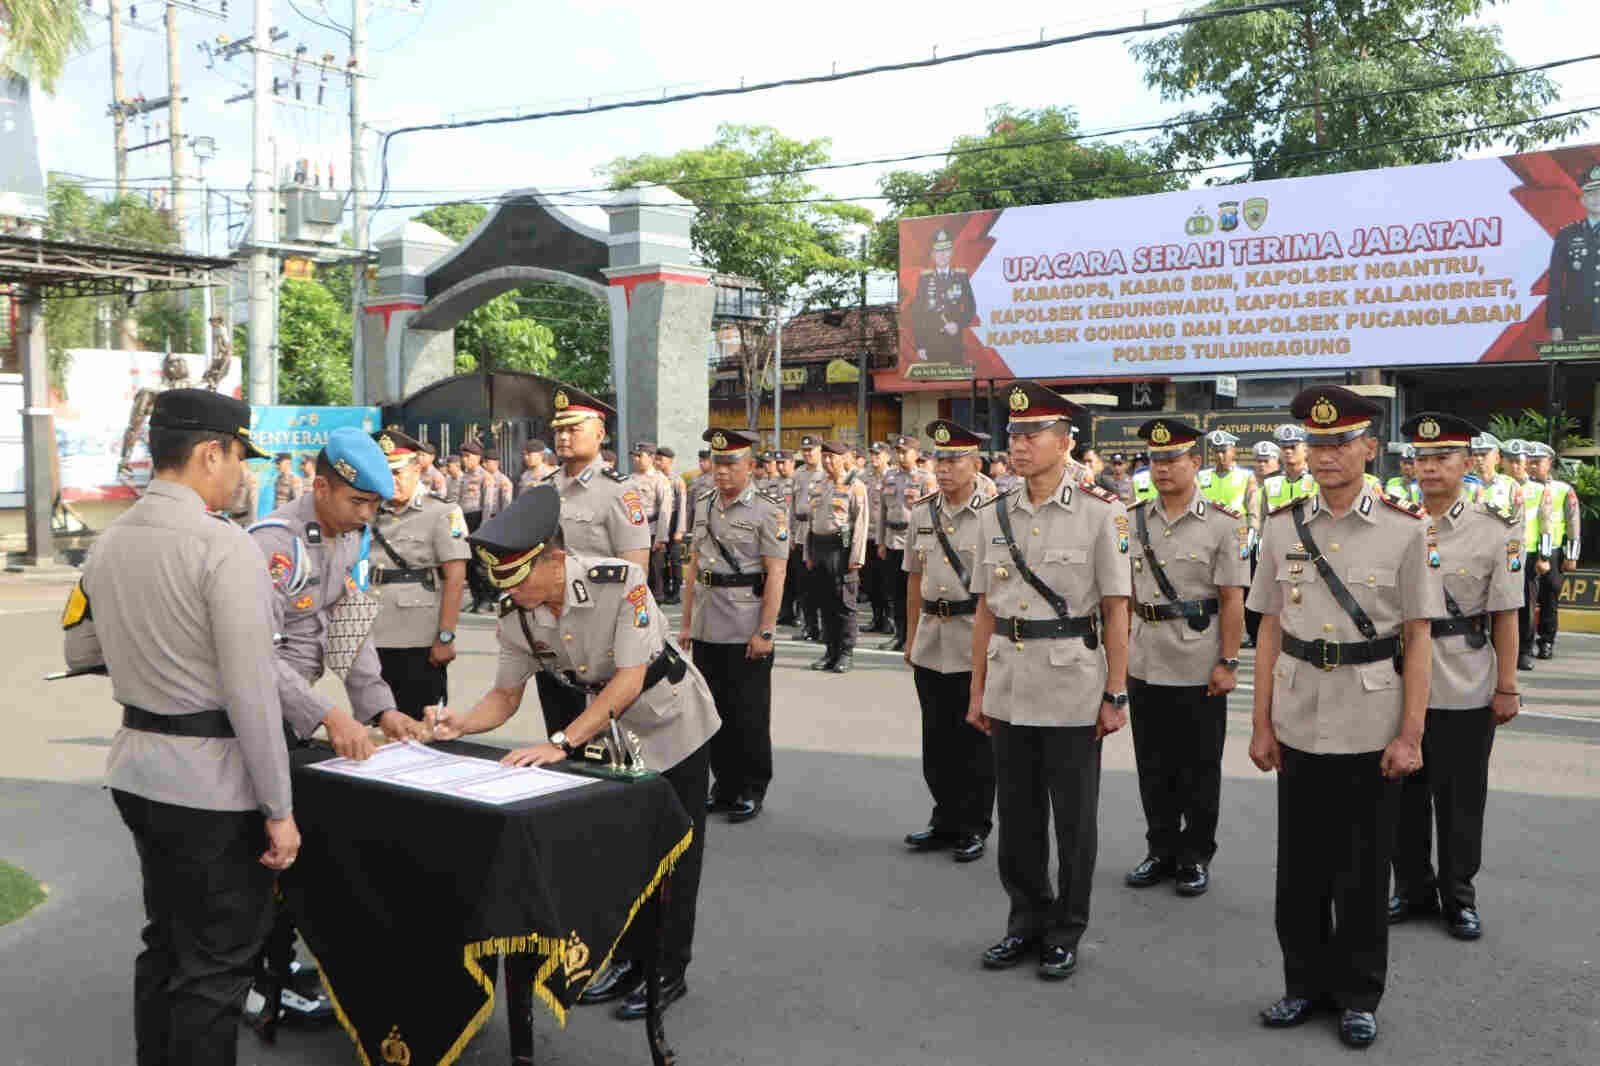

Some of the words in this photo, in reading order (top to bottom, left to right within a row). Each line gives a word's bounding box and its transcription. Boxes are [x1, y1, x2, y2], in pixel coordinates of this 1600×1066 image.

[1003, 249, 1127, 282] UPACARA
[1132, 240, 1224, 273] SERAH
[1229, 231, 1344, 265] TERIMA
[1349, 217, 1501, 257] JABATAN
[1120, 275, 1184, 295] KABAG
[1245, 264, 1358, 288] KAPOLSEK
[1365, 255, 1485, 281] NGANTRU,
[991, 305, 1082, 324] KAPOLSEK
[1088, 296, 1229, 319] KEDUNGWARU,
[1235, 288, 1347, 311] KAPOLSEK
[1354, 277, 1516, 304] KALANGBRET,
[987, 327, 1079, 345] KAPOLSEK
[1084, 322, 1176, 342] GONDANG
[1182, 319, 1221, 337] DAN
[1228, 311, 1339, 334] KAPOLSEK
[1345, 304, 1521, 328] PUCANGLABAN
[1113, 344, 1186, 362] POLRES
[1192, 338, 1350, 360] TULUNGAGUNG
